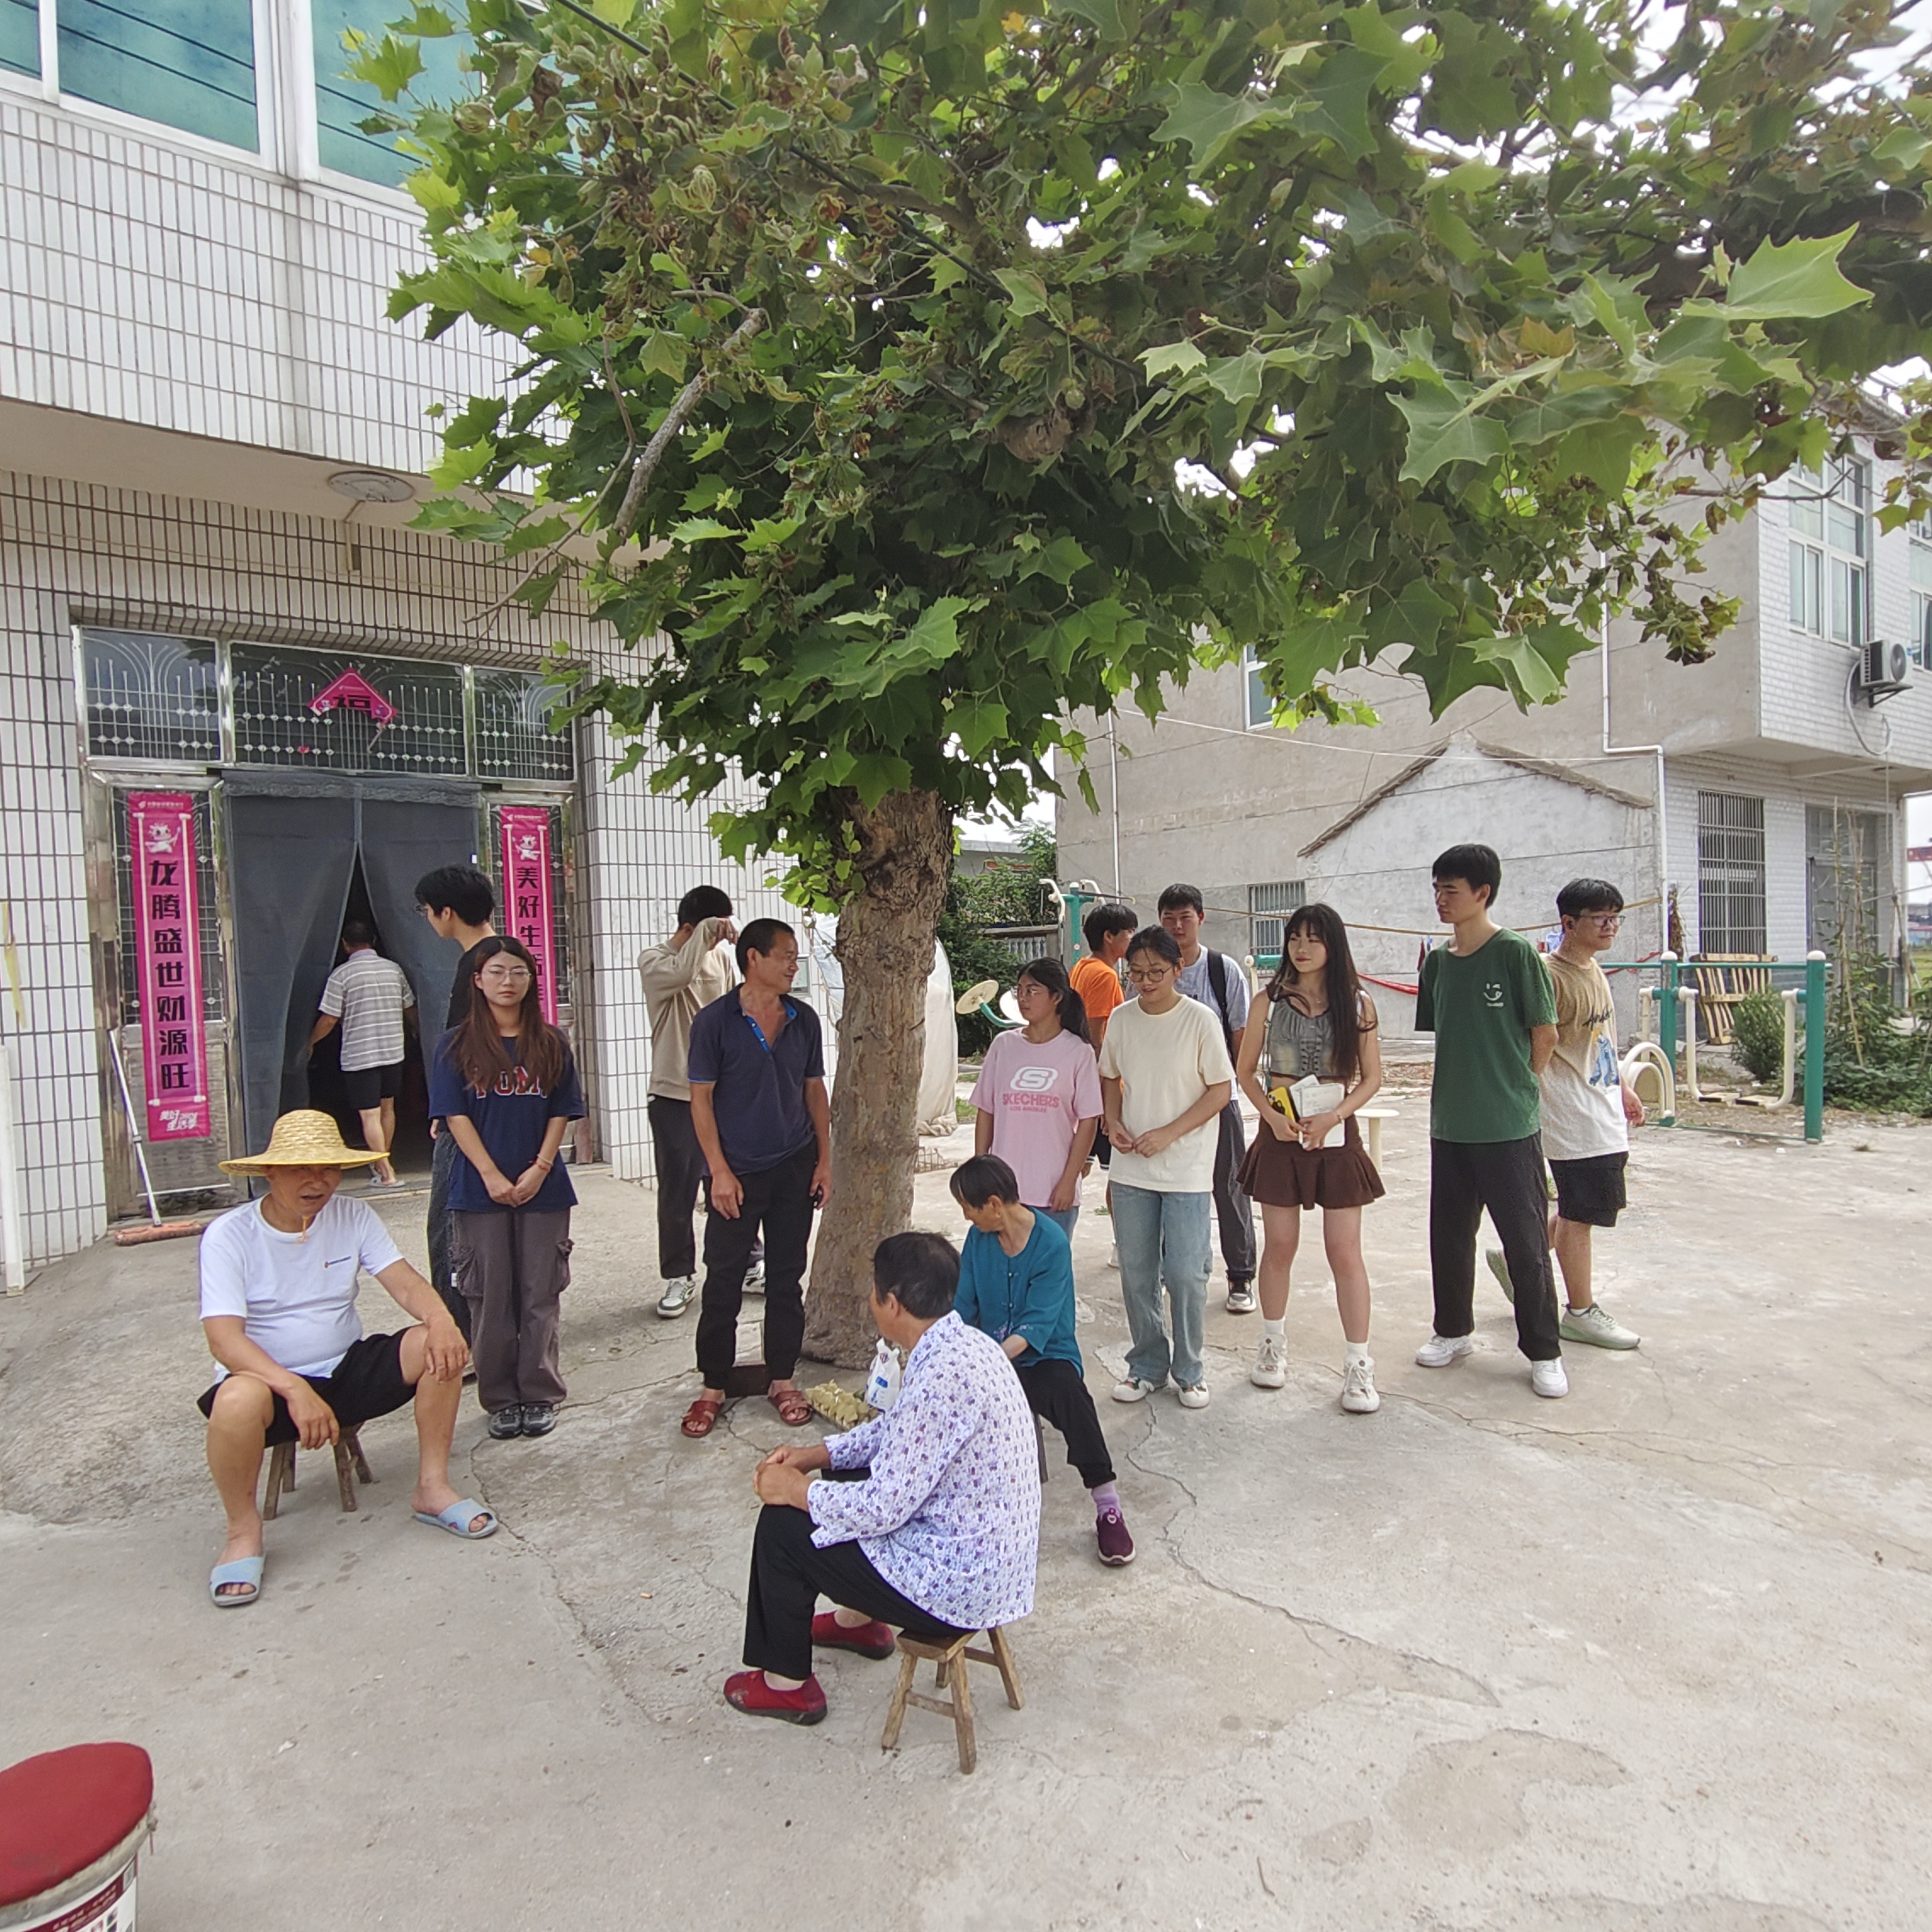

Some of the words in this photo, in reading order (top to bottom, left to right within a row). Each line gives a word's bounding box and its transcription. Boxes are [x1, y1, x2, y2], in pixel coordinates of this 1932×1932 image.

[149, 860, 190, 1090] 龙腾盛世财源旺
[1002, 1093, 1059, 1108] SKECHERS
